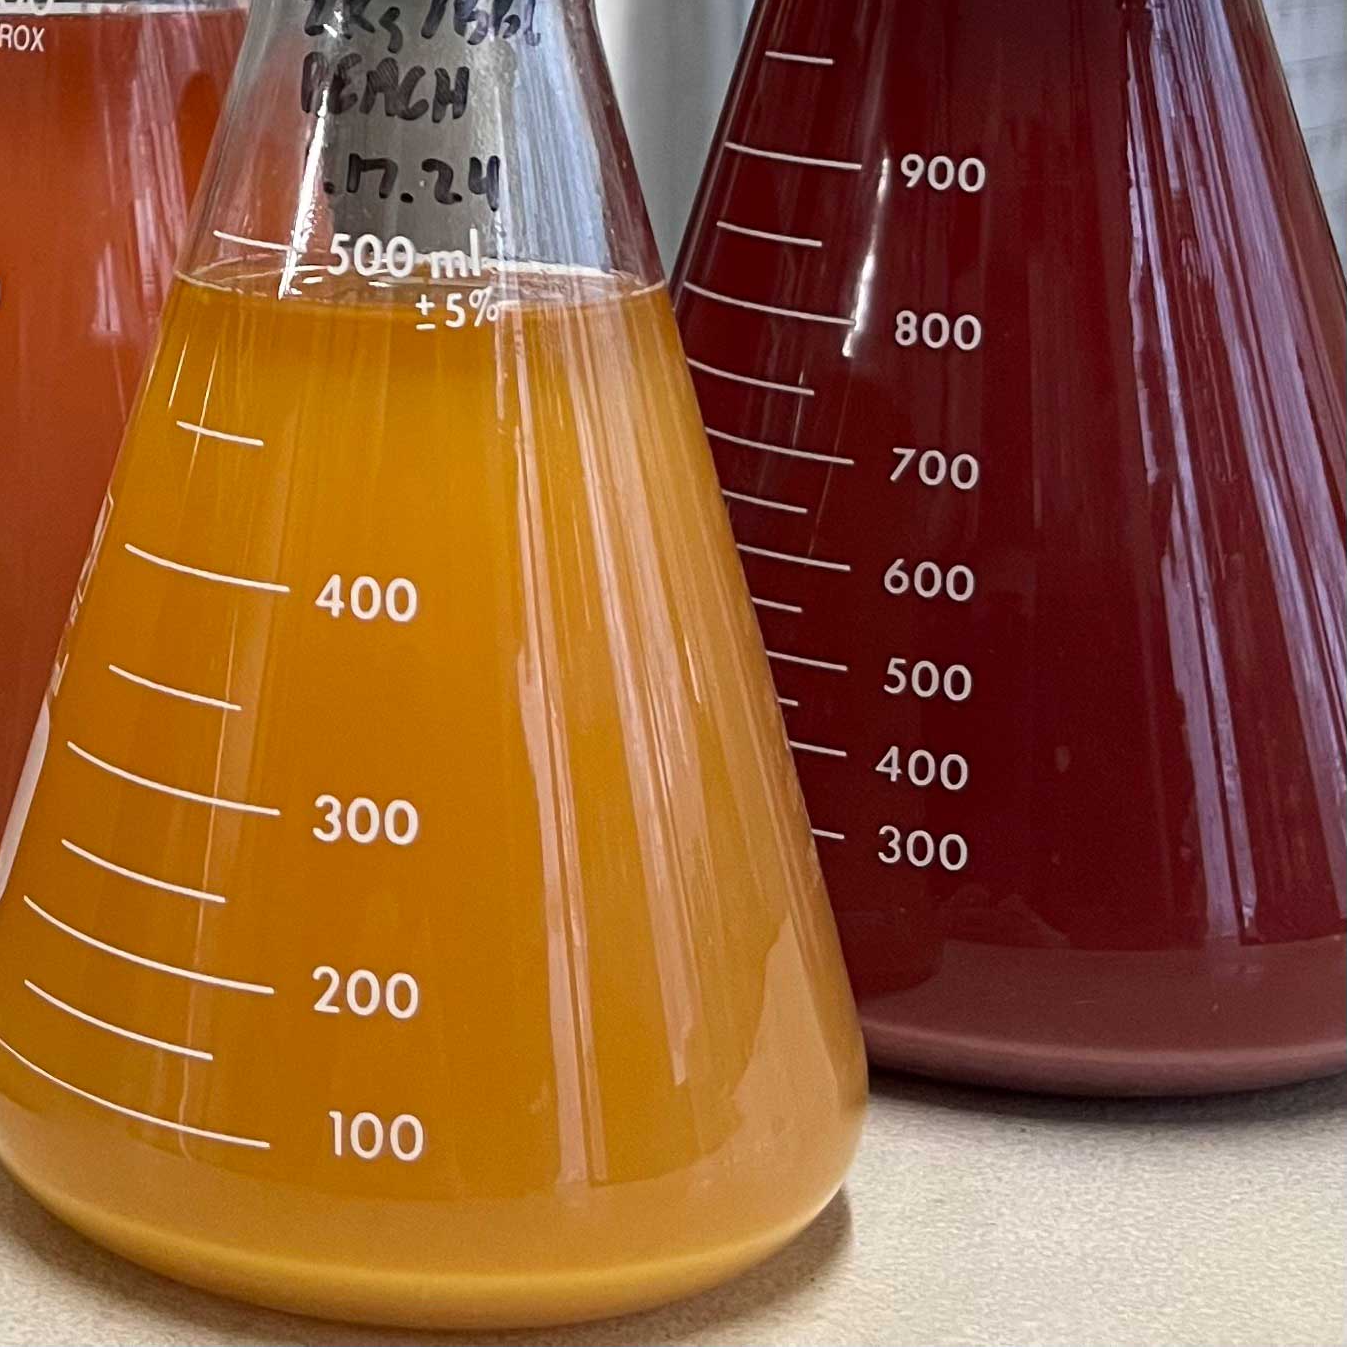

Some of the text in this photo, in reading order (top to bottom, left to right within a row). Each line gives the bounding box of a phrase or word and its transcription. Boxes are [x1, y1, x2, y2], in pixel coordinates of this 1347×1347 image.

[301, 52, 470, 123] PEACH
[322, 153, 501, 212] .17.24
[900, 152, 986, 194] 900
[327, 228, 481, 278] 500 ml
[894, 309, 983, 351] 800
[889, 447, 980, 490] 700
[314, 574, 418, 623] 400
[884, 558, 976, 602] 600
[884, 658, 973, 702] 500
[875, 745, 969, 791] 400
[311, 794, 420, 846] 300
[877, 825, 968, 872] 300
[311, 965, 420, 1019] 200
[329, 1110, 424, 1159] 100
